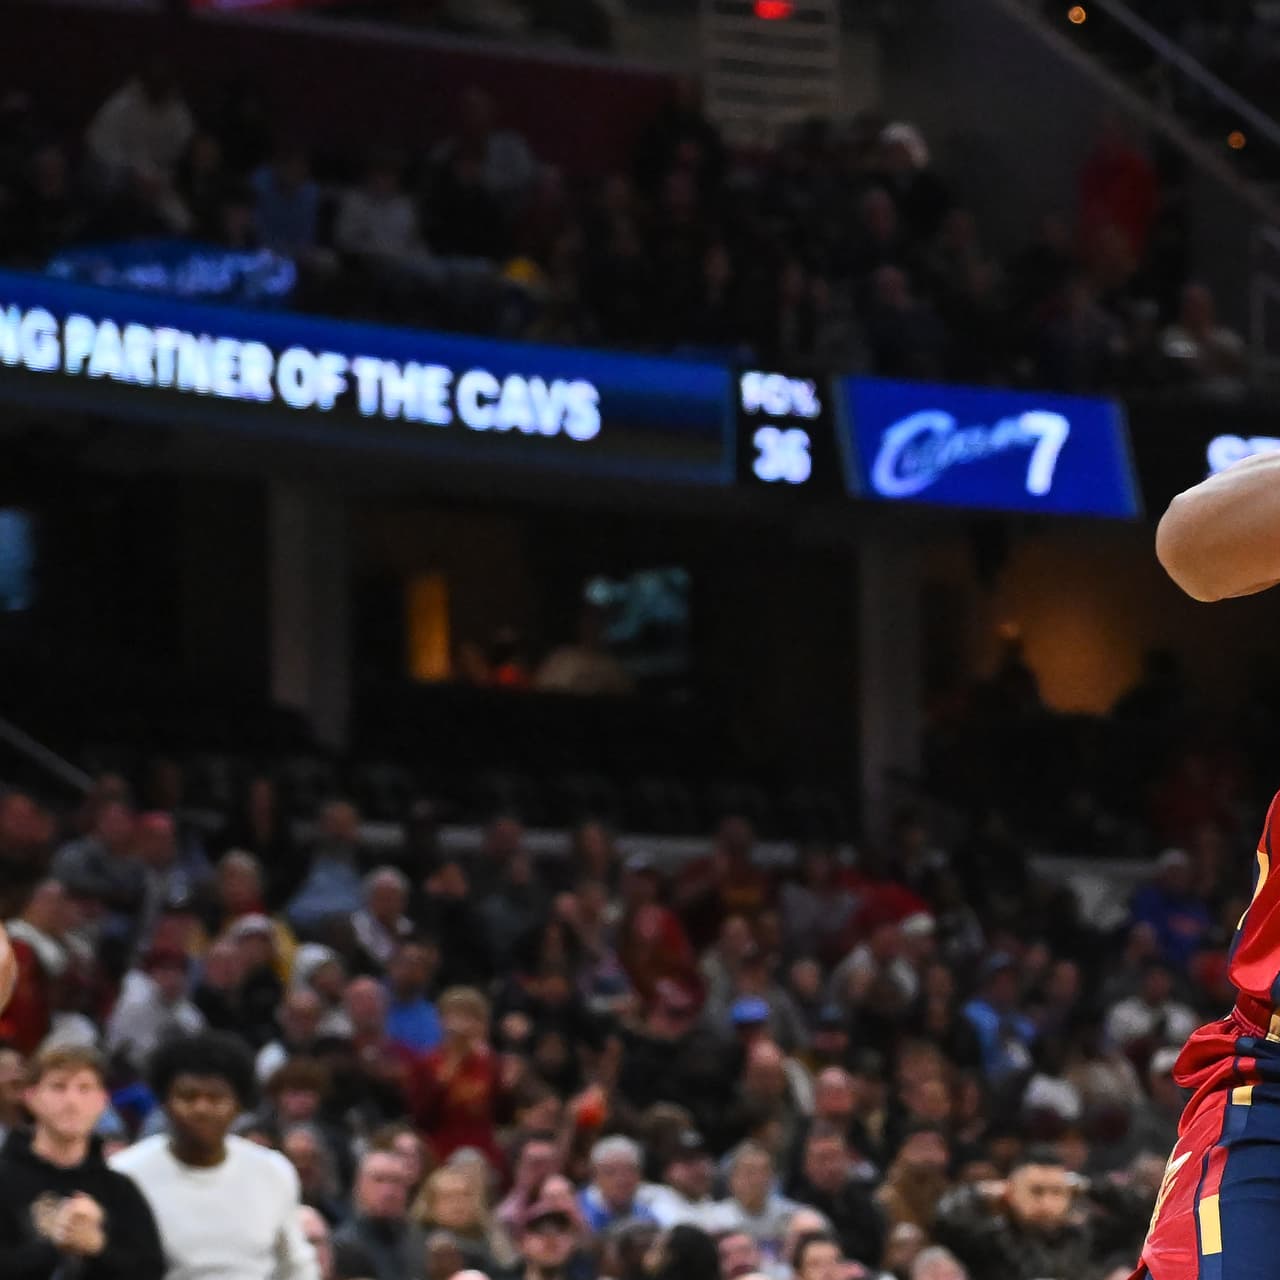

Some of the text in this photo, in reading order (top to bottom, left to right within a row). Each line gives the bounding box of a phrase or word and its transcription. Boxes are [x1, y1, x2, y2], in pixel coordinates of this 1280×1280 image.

[64, 313, 273, 401] PARTNER
[277, 347, 349, 411] OF
[351, 356, 454, 425] THE
[456, 370, 600, 440] CAVS
